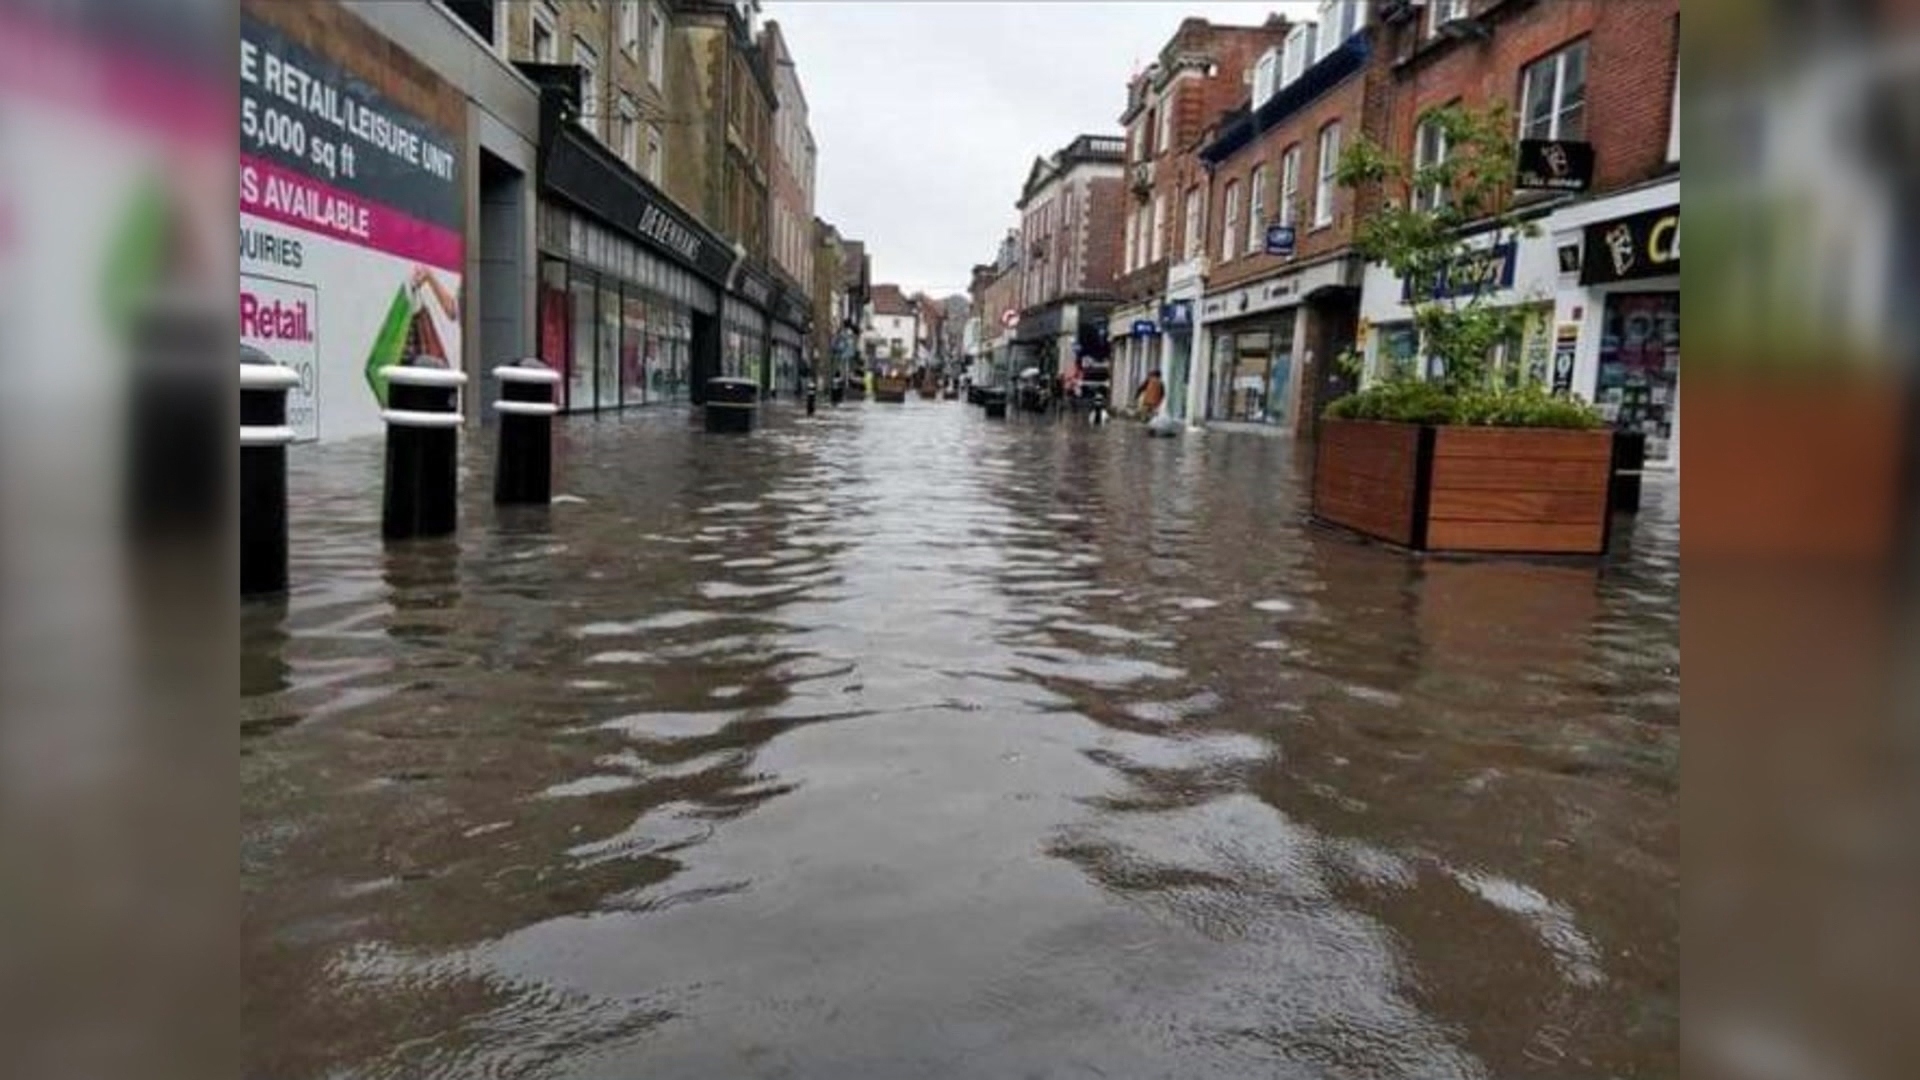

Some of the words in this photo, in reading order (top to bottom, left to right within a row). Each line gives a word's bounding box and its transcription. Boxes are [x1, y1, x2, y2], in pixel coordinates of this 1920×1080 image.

[240, 39, 257, 83] E
[264, 52, 419, 165] RETAIL/LEISURE
[422, 142, 454, 180] UNIT
[241, 98, 305, 157] 5,000
[310, 136, 335, 178] sq
[340, 143, 355, 178] ft
[240, 165, 259, 204] S
[264, 175, 370, 238] AVAILABLE
[240, 291, 313, 342] Retail.
